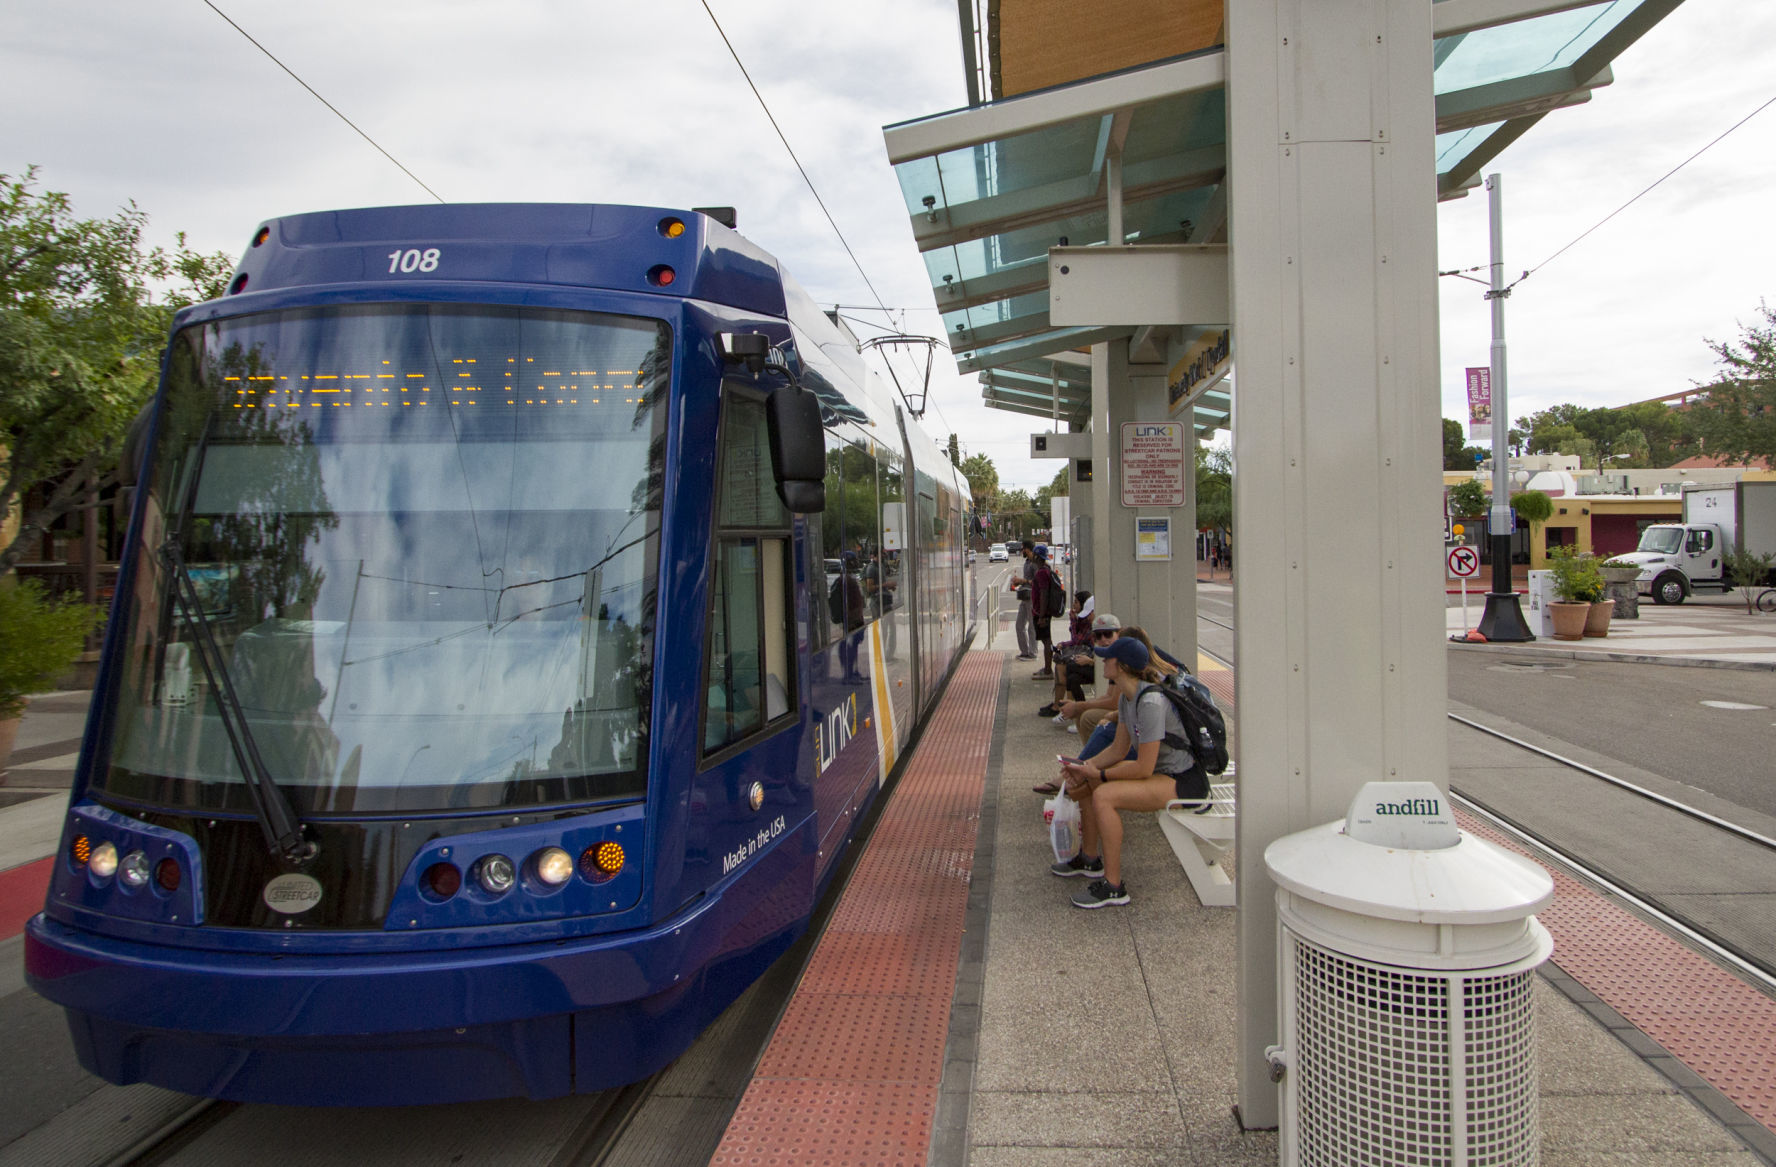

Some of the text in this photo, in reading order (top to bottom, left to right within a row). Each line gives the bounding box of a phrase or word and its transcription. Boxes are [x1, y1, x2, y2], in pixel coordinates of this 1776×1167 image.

[388, 248, 441, 273] 108
[1469, 375, 1479, 403] Fashion
[1478, 369, 1489, 400] Forward
[1705, 497, 1717, 508] 24
[1376, 798, 1439, 815] andfill
[723, 815, 786, 875] Made in the USA
